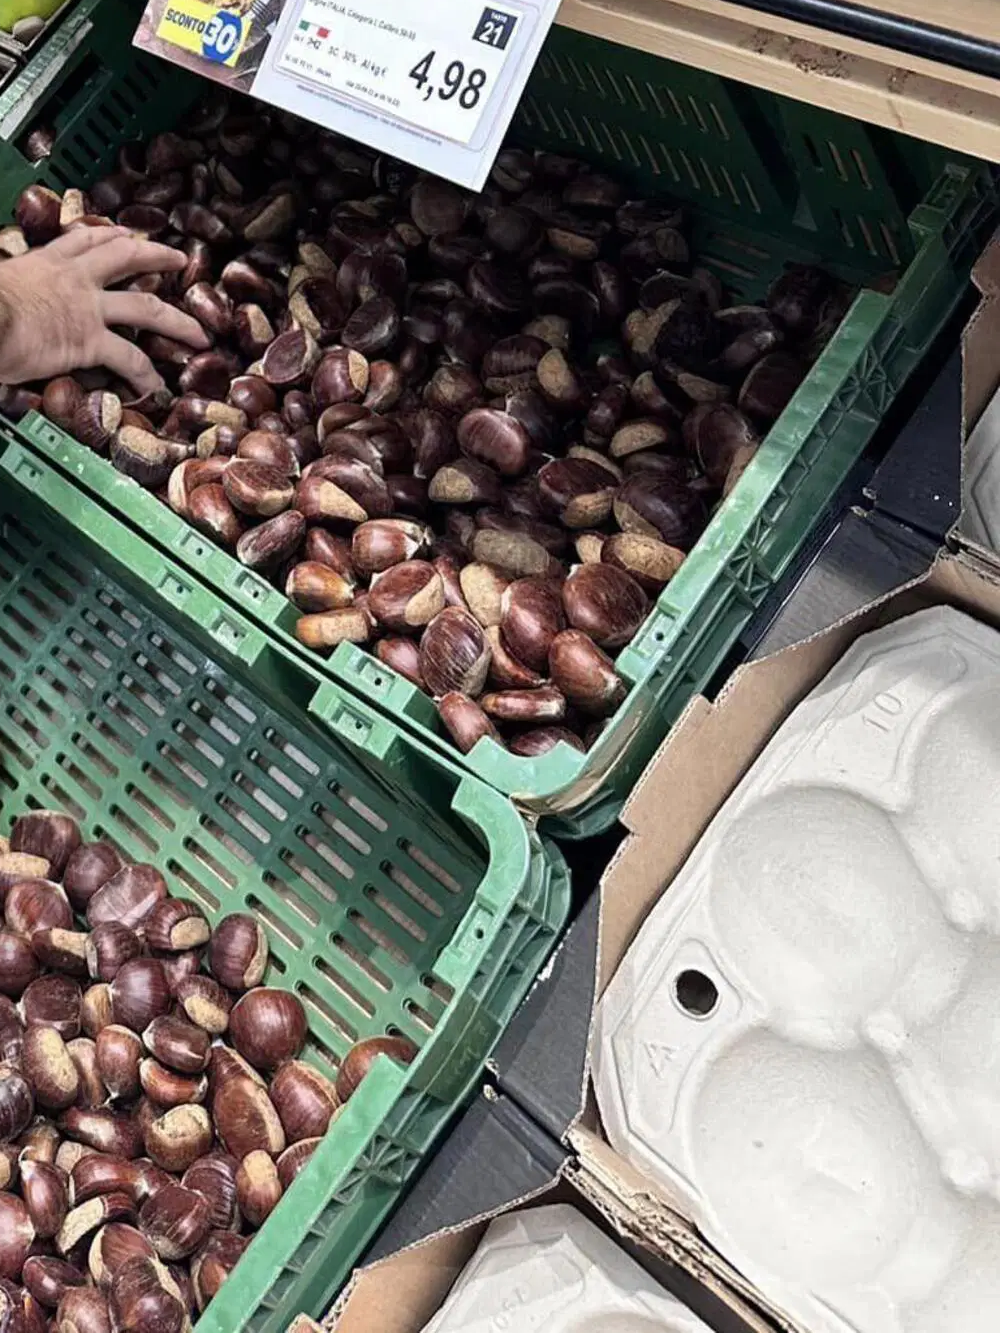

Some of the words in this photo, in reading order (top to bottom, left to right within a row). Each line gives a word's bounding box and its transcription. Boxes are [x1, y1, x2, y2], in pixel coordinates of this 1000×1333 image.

[165, 8, 206, 34] SCONTO
[478, 21, 505, 46] 21
[409, 50, 488, 110] 4,98
